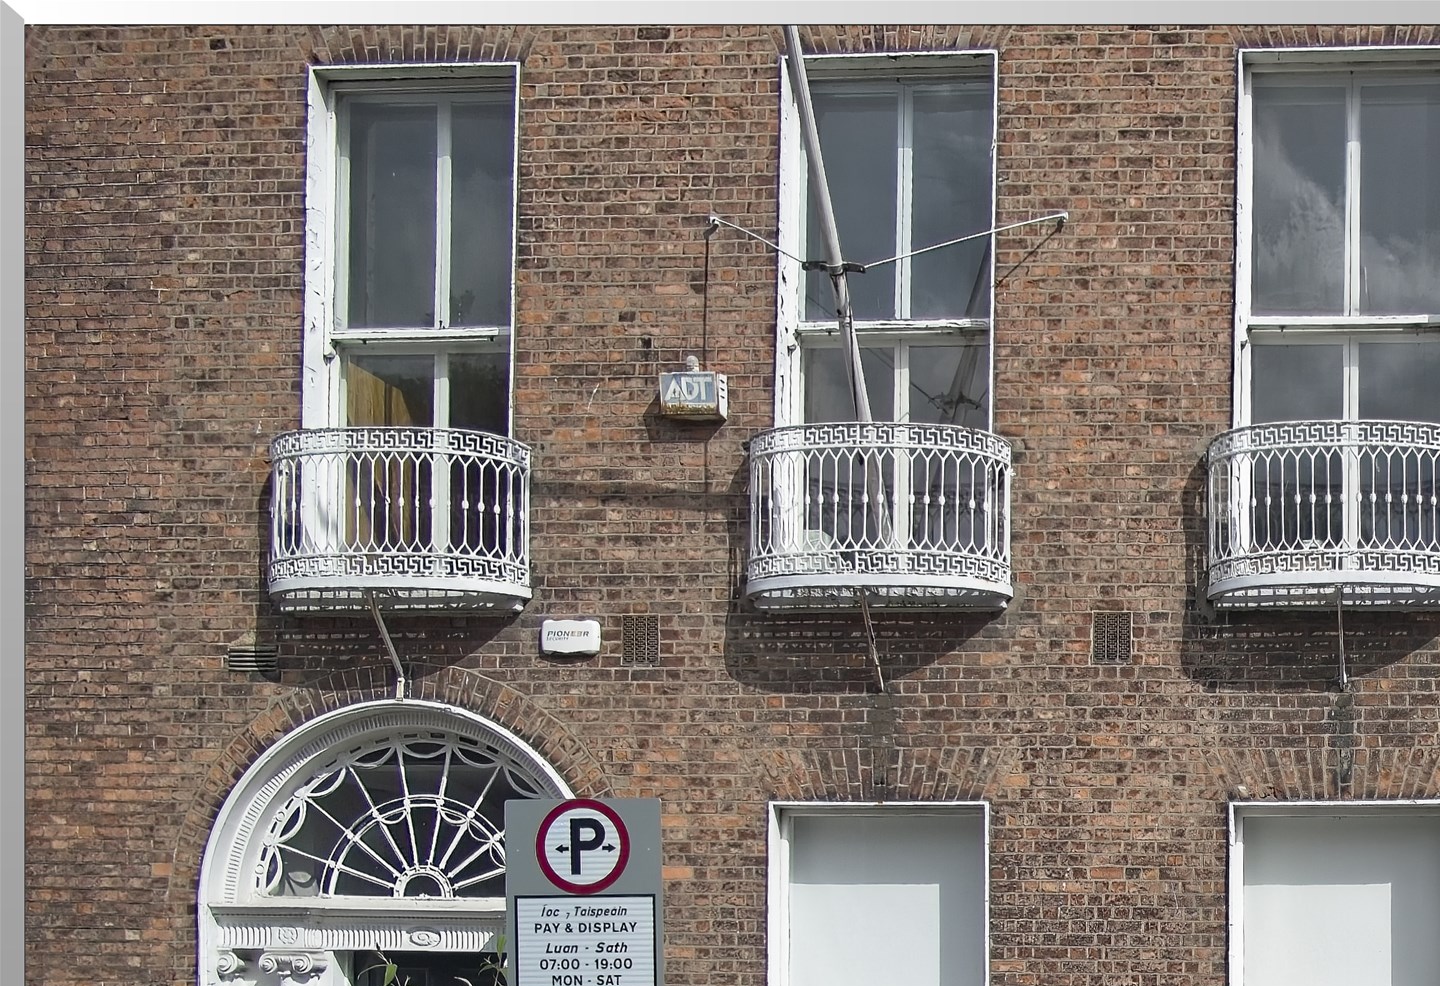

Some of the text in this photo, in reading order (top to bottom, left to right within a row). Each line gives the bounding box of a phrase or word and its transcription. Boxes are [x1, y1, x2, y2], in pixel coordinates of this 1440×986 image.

[664, 376, 712, 401] ADT
[570, 817, 606, 875] P
[534, 922, 638, 933] PAY & DISPLAY
[546, 943, 578, 954] Luan
[595, 942, 628, 953] Sath
[539, 958, 580, 970] 07:00
[595, 958, 633, 970] 19:00
[552, 975, 583, 986] MON
[596, 974, 622, 986] SAT
